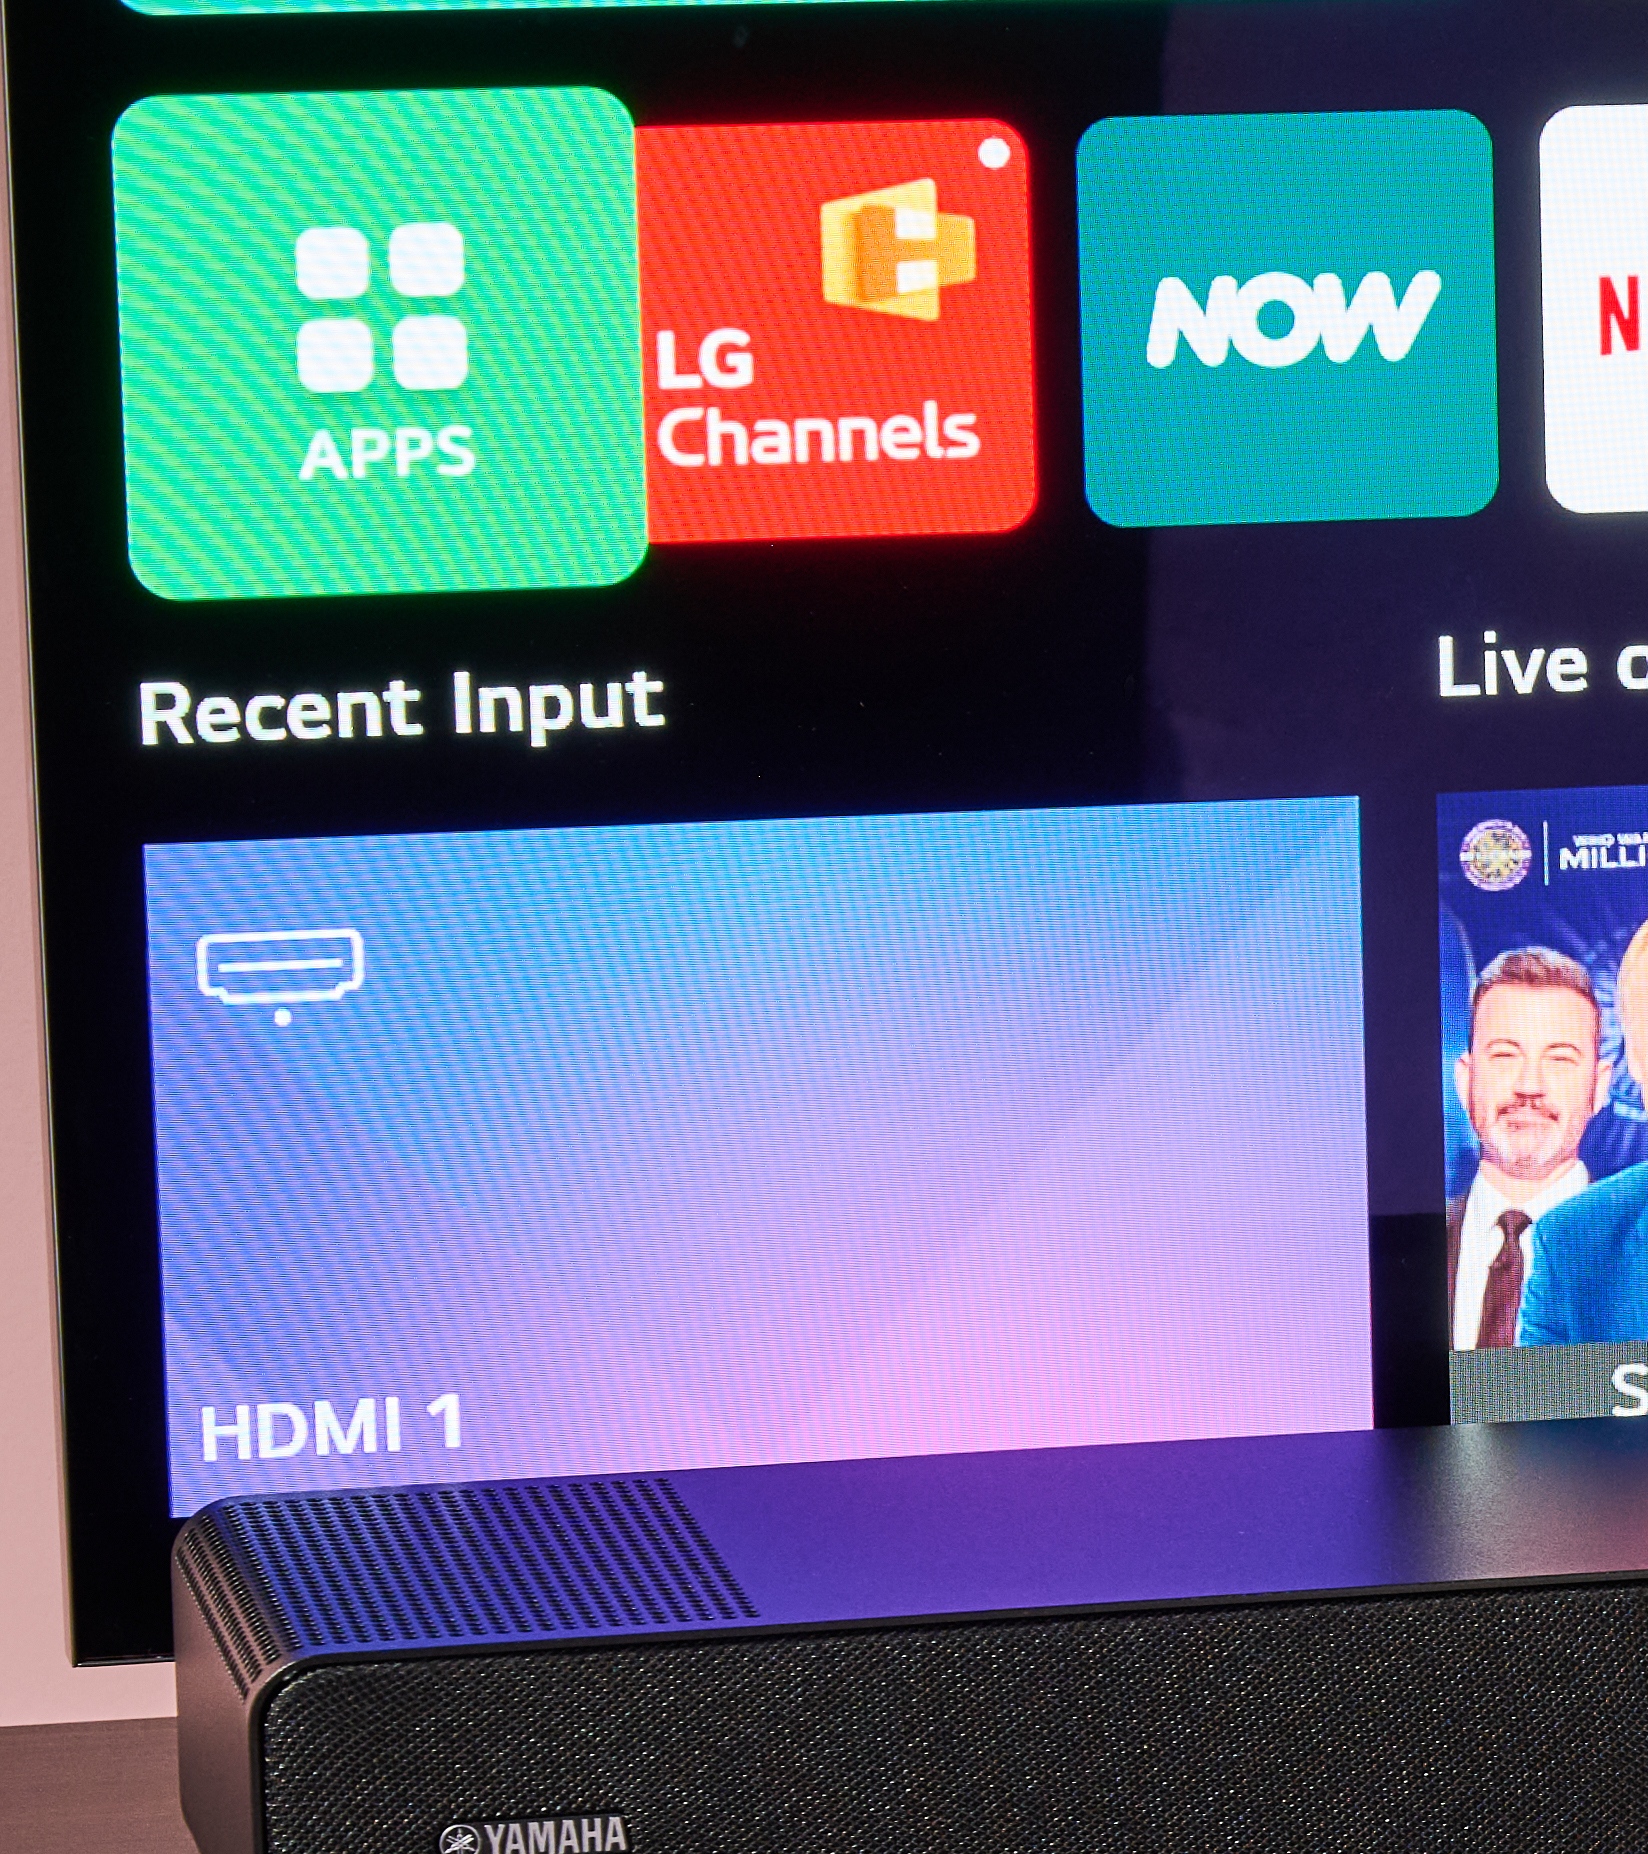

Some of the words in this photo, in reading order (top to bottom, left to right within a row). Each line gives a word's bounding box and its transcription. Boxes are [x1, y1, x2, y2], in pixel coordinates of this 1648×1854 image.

[1146, 269, 1442, 369] NOW
[657, 328, 754, 390] LG
[298, 425, 475, 479] APPS
[657, 400, 980, 469] Channels
[1438, 630, 1588, 699] Live
[139, 679, 421, 745] Recent
[453, 670, 665, 746] Input
[201, 1394, 402, 1461] HDMI
[427, 1392, 463, 1449] 1
